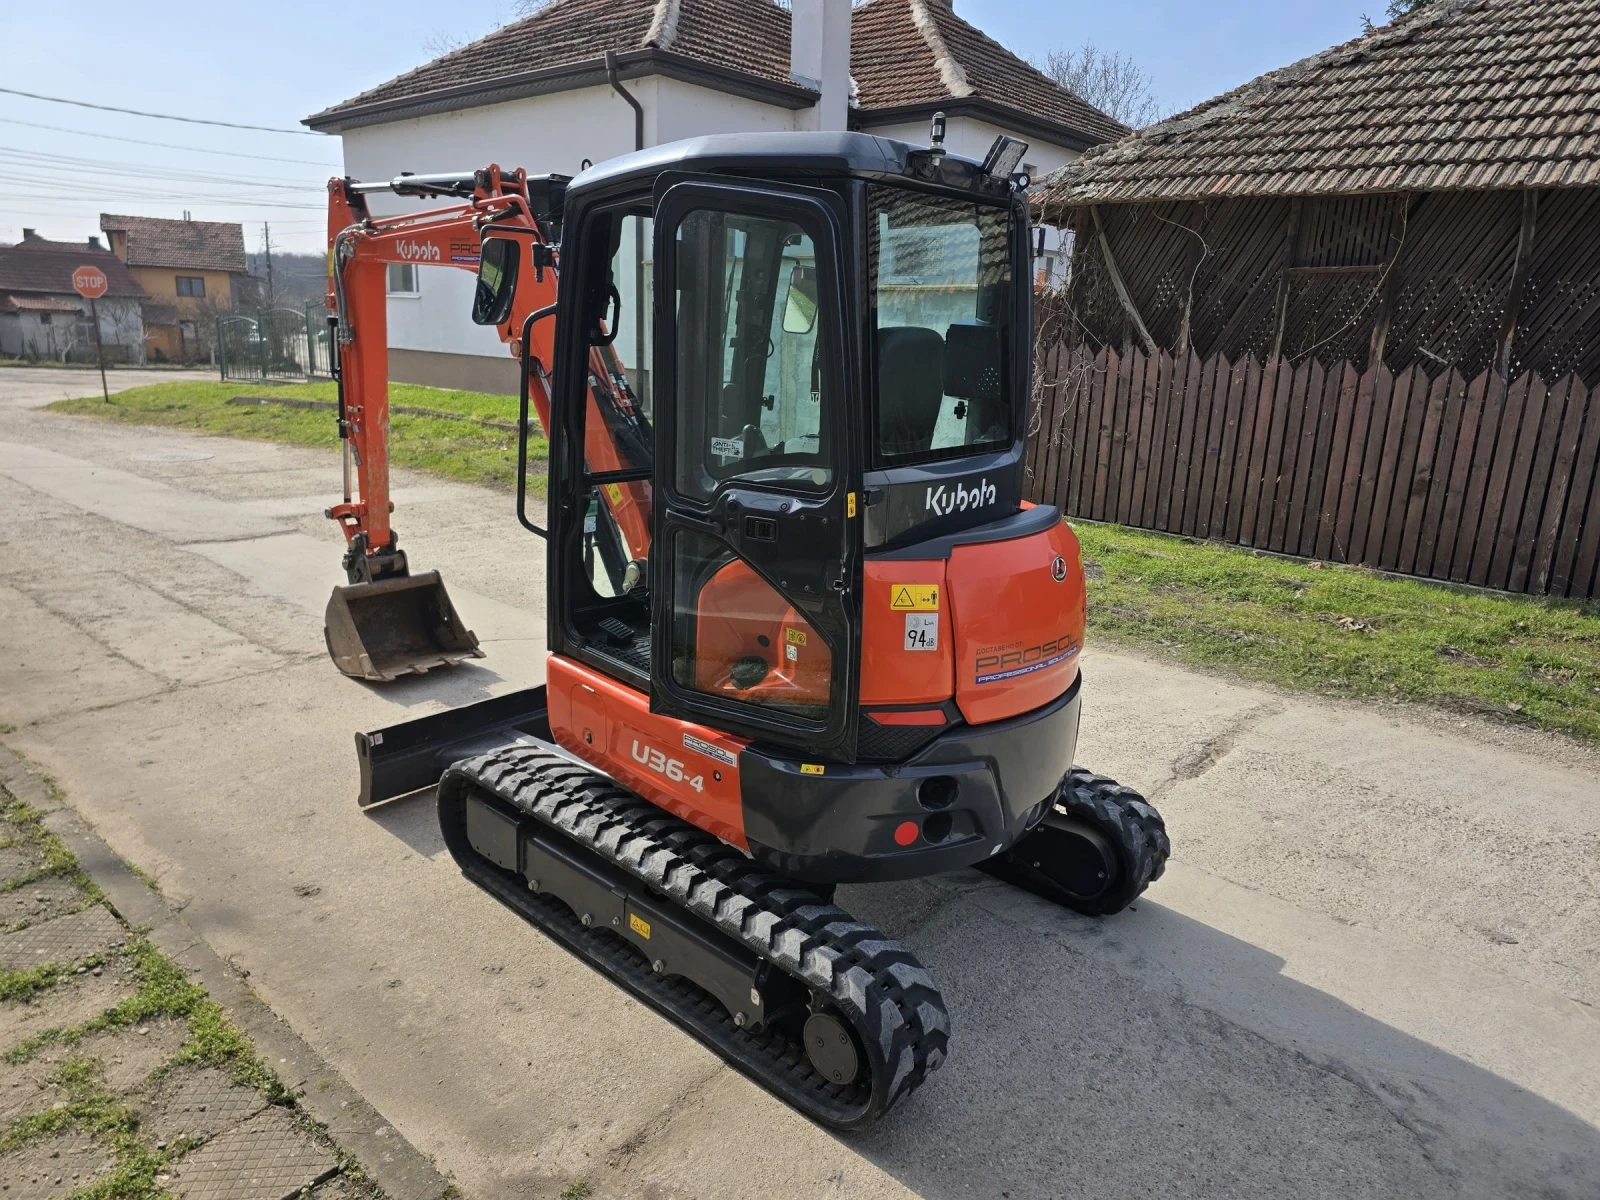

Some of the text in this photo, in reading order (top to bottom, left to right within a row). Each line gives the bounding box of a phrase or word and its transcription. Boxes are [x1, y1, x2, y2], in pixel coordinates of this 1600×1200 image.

[396, 240, 440, 260] Kubota
[451, 243, 481, 254] PRO
[76, 276, 104, 288] STOP
[925, 478, 996, 516] Kubota
[975, 634, 1078, 673] PROSOL
[976, 643, 1015, 655] ДОСТАВЕНО
[978, 662, 1047, 682] PROFESSIONAL
[685, 735, 733, 760] PROSOL
[632, 739, 704, 793] U36-4
